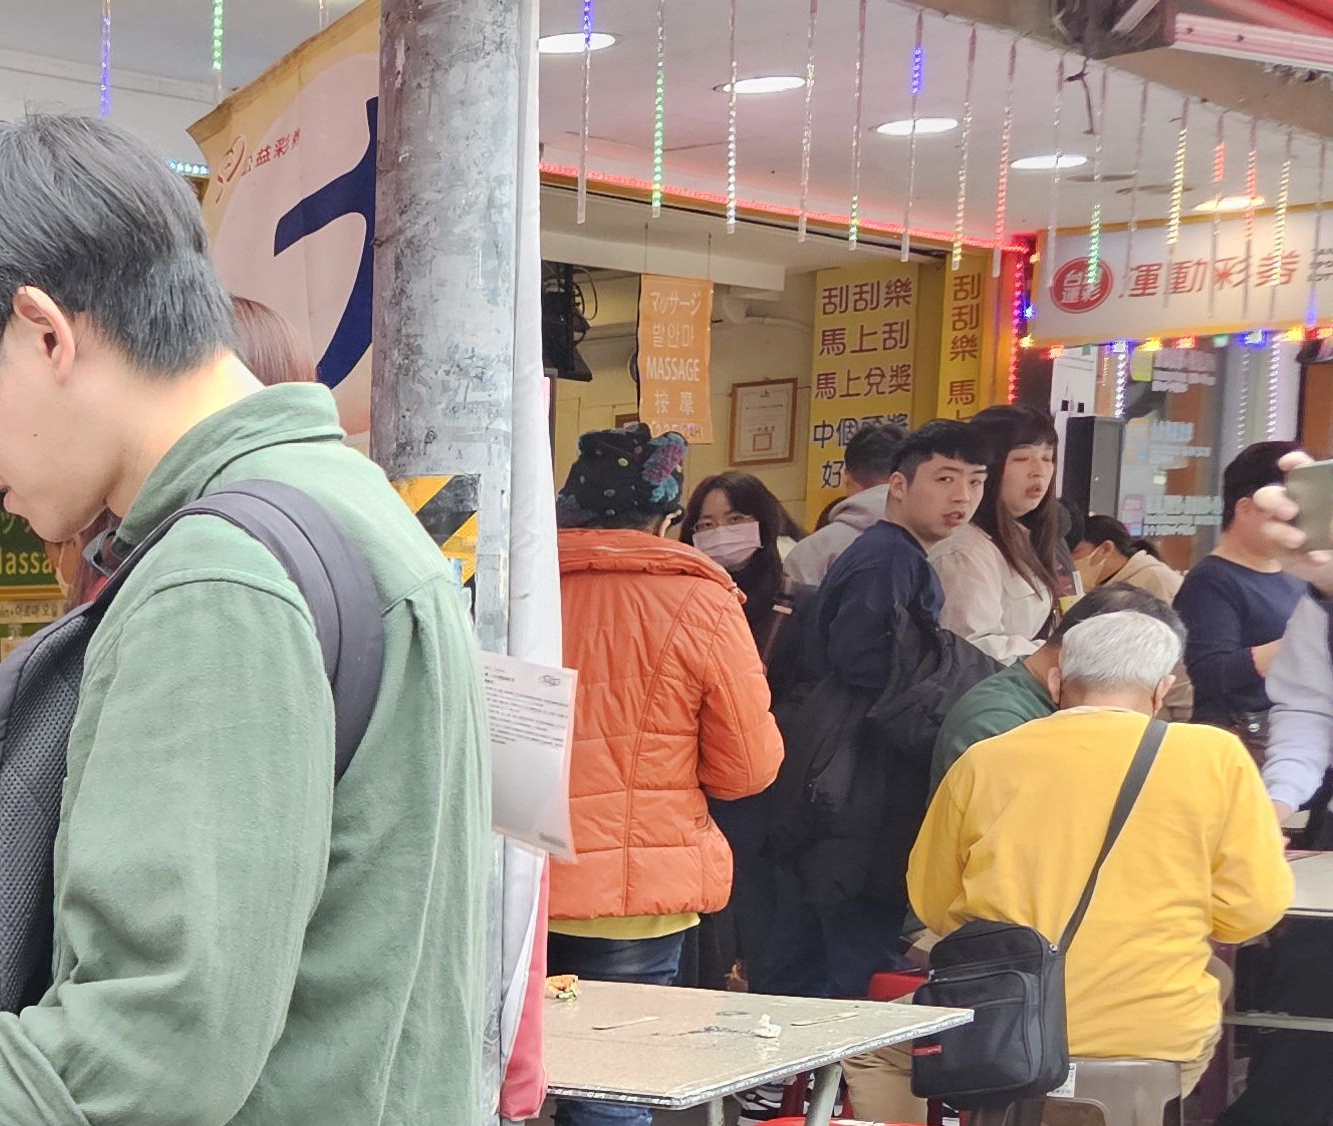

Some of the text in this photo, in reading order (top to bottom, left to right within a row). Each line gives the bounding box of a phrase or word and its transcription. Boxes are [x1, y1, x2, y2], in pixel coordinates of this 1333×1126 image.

[649, 290, 702, 316] マッサージ
[822, 276, 913, 316] 刮刮樂
[950, 273, 982, 362] 刮刮樂
[818, 319, 911, 357] 馬上刮
[646, 354, 701, 382] MASSAGE
[814, 363, 912, 400] 馬上兌獎
[653, 388, 695, 416] 按摩
